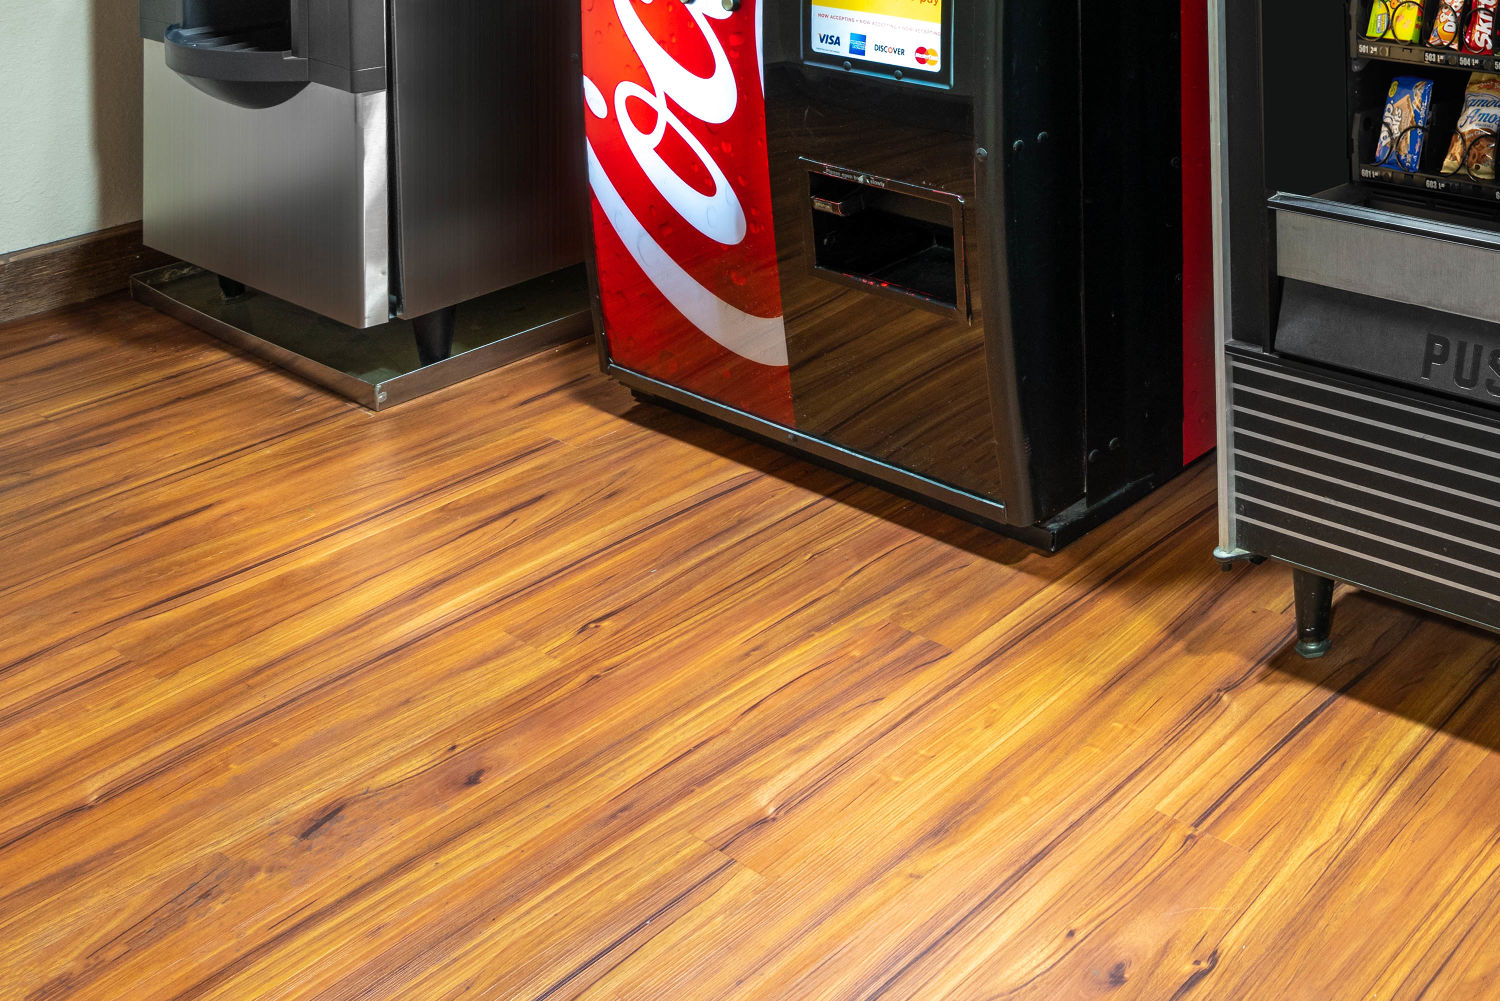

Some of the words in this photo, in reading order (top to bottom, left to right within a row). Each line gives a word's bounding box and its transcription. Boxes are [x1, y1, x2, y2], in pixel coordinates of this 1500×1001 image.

[818, 33, 841, 47] VISA
[874, 43, 905, 56] DISCOVER
[1359, 45, 1369, 53] 501
[1425, 53, 1436, 62] 503
[1460, 57, 1470, 66] 504
[1425, 180, 1437, 189] 603
